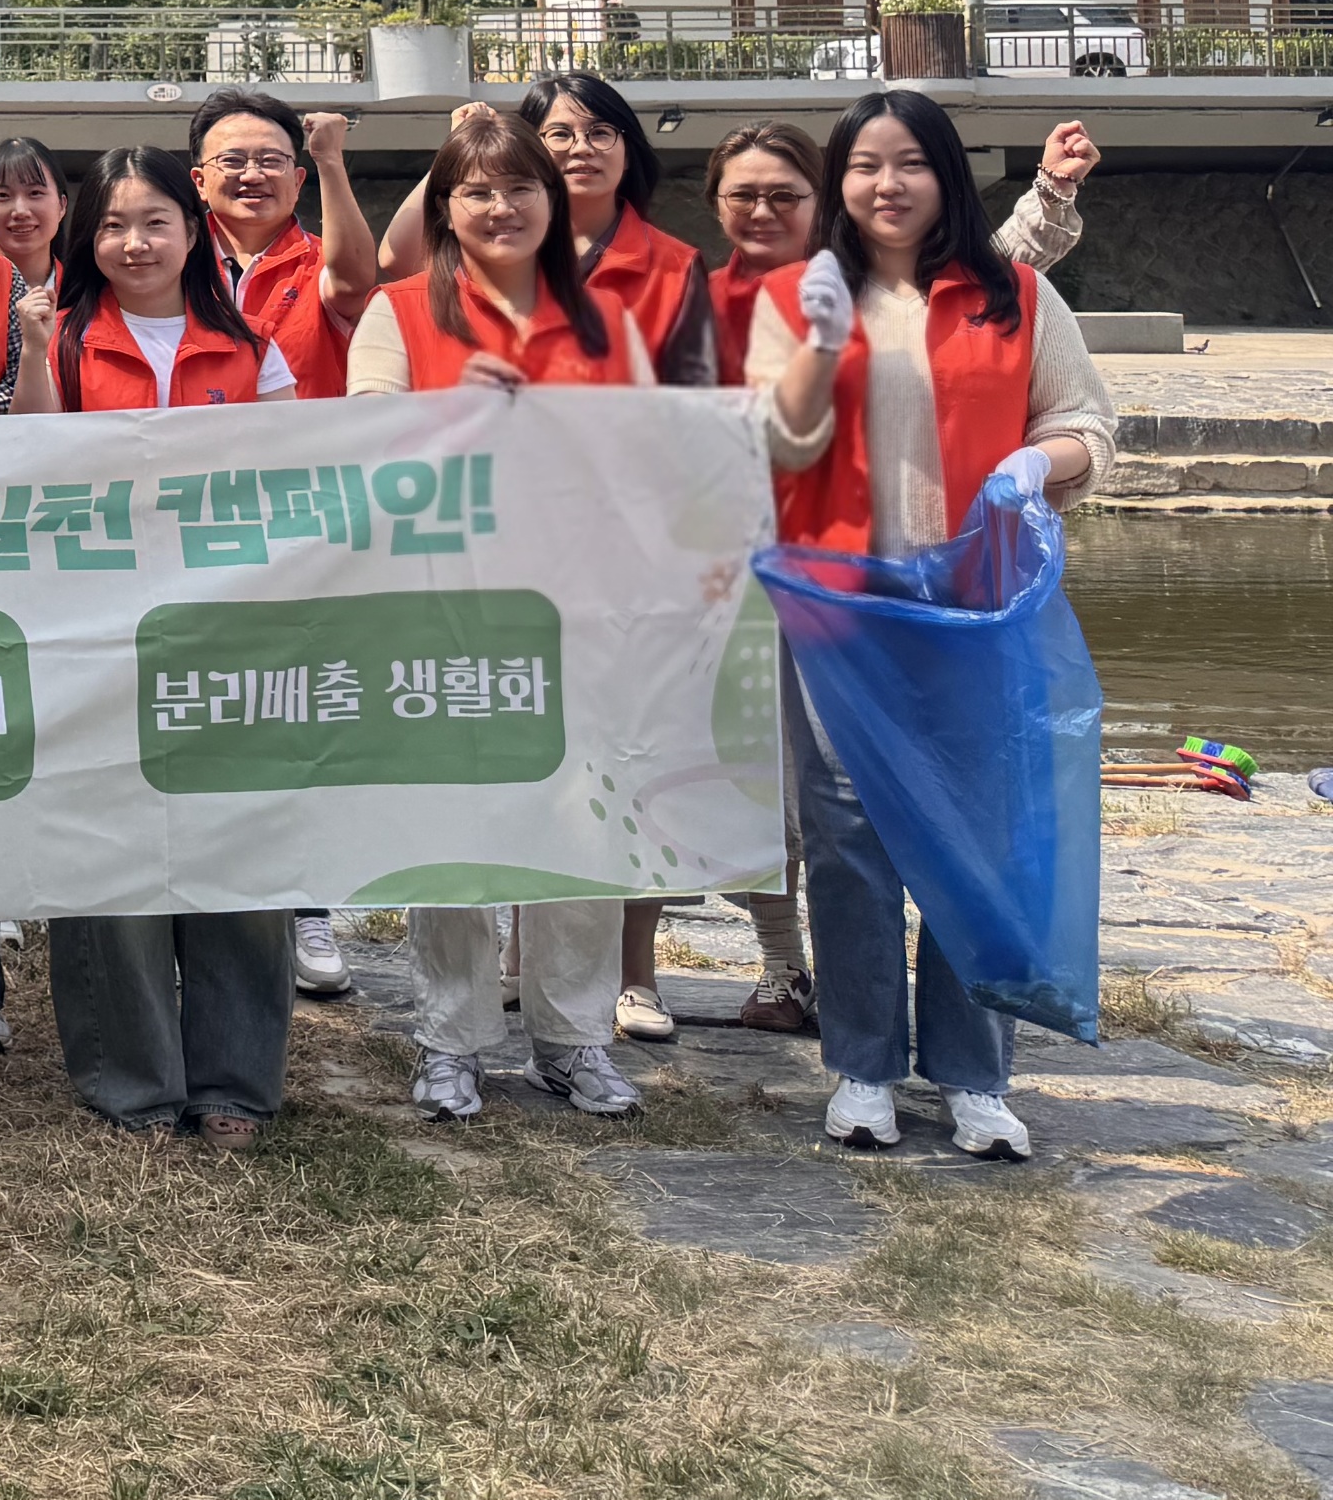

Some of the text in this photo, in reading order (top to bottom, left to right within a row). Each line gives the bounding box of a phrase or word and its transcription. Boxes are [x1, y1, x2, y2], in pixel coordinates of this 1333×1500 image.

[155, 452, 497, 569] 캠페인!
[150, 655, 552, 732] 분리배출 생활화
